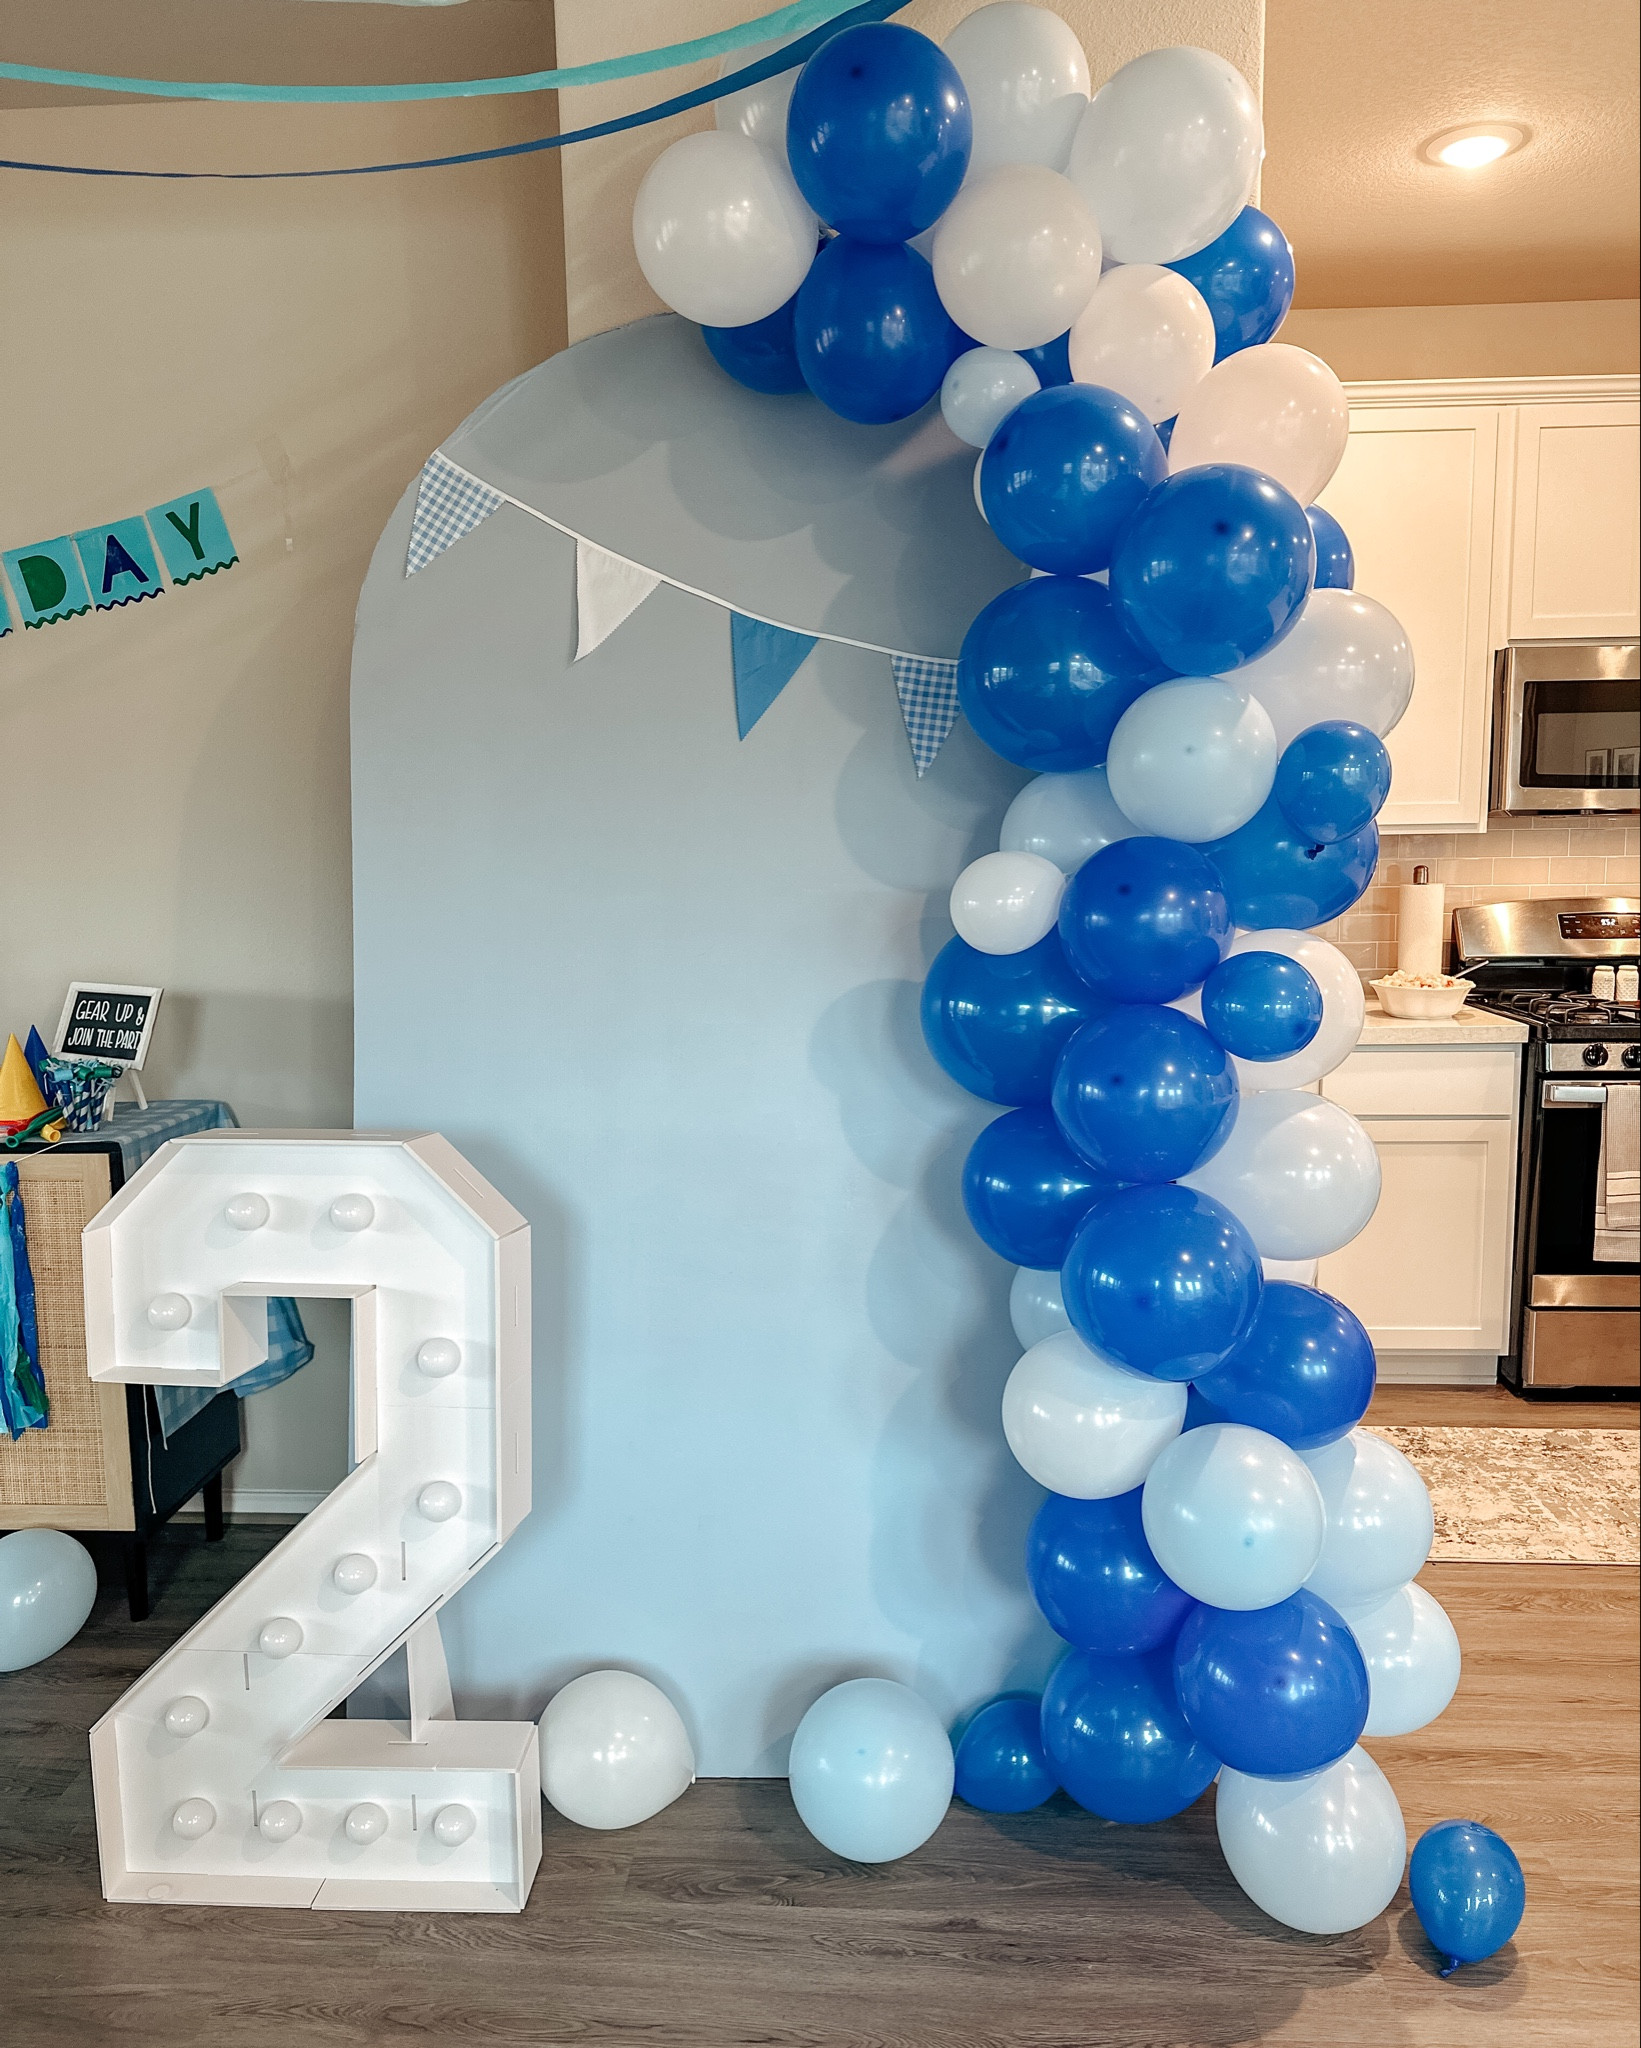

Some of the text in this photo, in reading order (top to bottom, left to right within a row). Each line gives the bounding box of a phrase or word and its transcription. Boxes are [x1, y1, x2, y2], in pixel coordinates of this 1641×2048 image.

[17, 501, 206, 613] DAY
[67, 1027, 95, 1047] JOIN
[96, 1028, 116, 1049] THE
[75, 999, 145, 1026] GEAR UP &
[82, 1130, 542, 1914] 2
